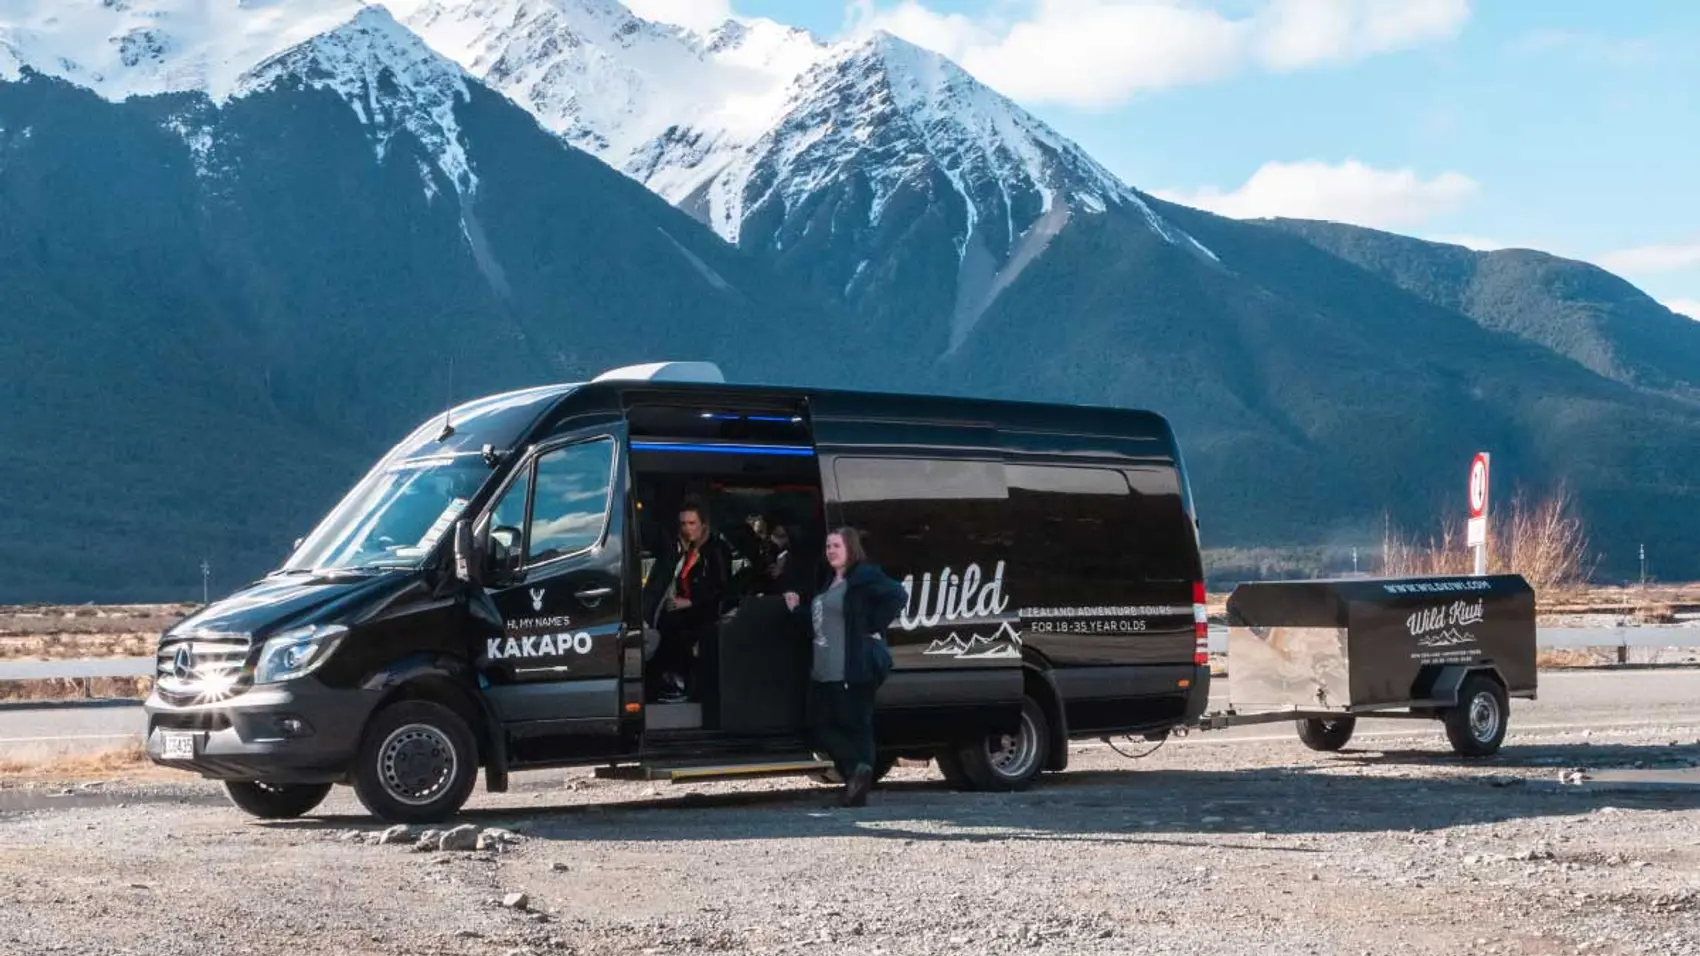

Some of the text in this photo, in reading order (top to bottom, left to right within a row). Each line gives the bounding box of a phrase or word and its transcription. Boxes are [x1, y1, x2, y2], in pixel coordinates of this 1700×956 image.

[900, 560, 1009, 631] Wild
[1027, 606, 1075, 617] ZEALAND
[1077, 605, 1137, 616] ADVENTURE
[1139, 605, 1173, 616] TOURS
[1406, 598, 1484, 636] Wild Kiwi
[520, 618, 533, 629] MY
[1031, 620, 1147, 633] FOR 18-35 YEAR OLDS
[487, 632, 593, 659] KAKAPO
